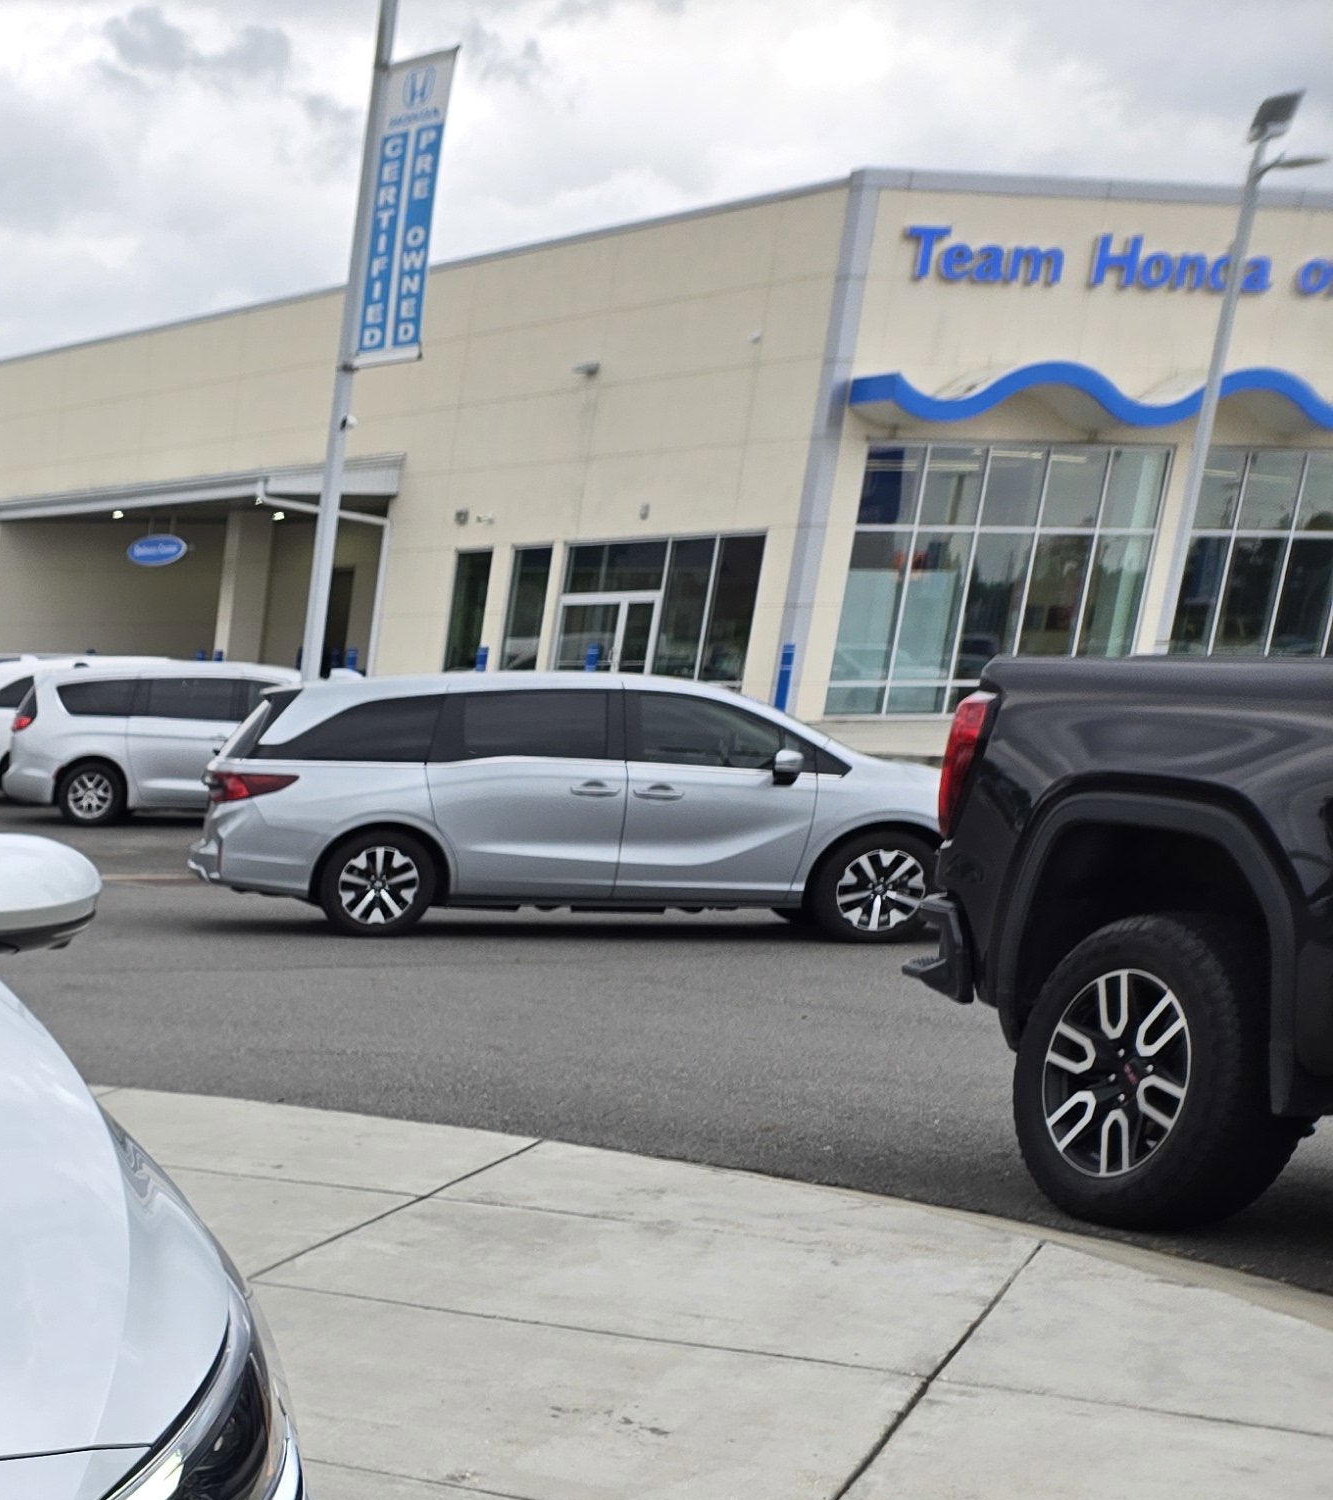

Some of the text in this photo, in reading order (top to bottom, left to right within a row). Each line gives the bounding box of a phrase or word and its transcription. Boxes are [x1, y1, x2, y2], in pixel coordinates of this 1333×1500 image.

[413, 128, 438, 200] PRE
[361, 136, 404, 348] CERTIFIED
[396, 225, 426, 342] OWNED
[906, 225, 1065, 286] Team
[1299, 257, 1333, 297] o
